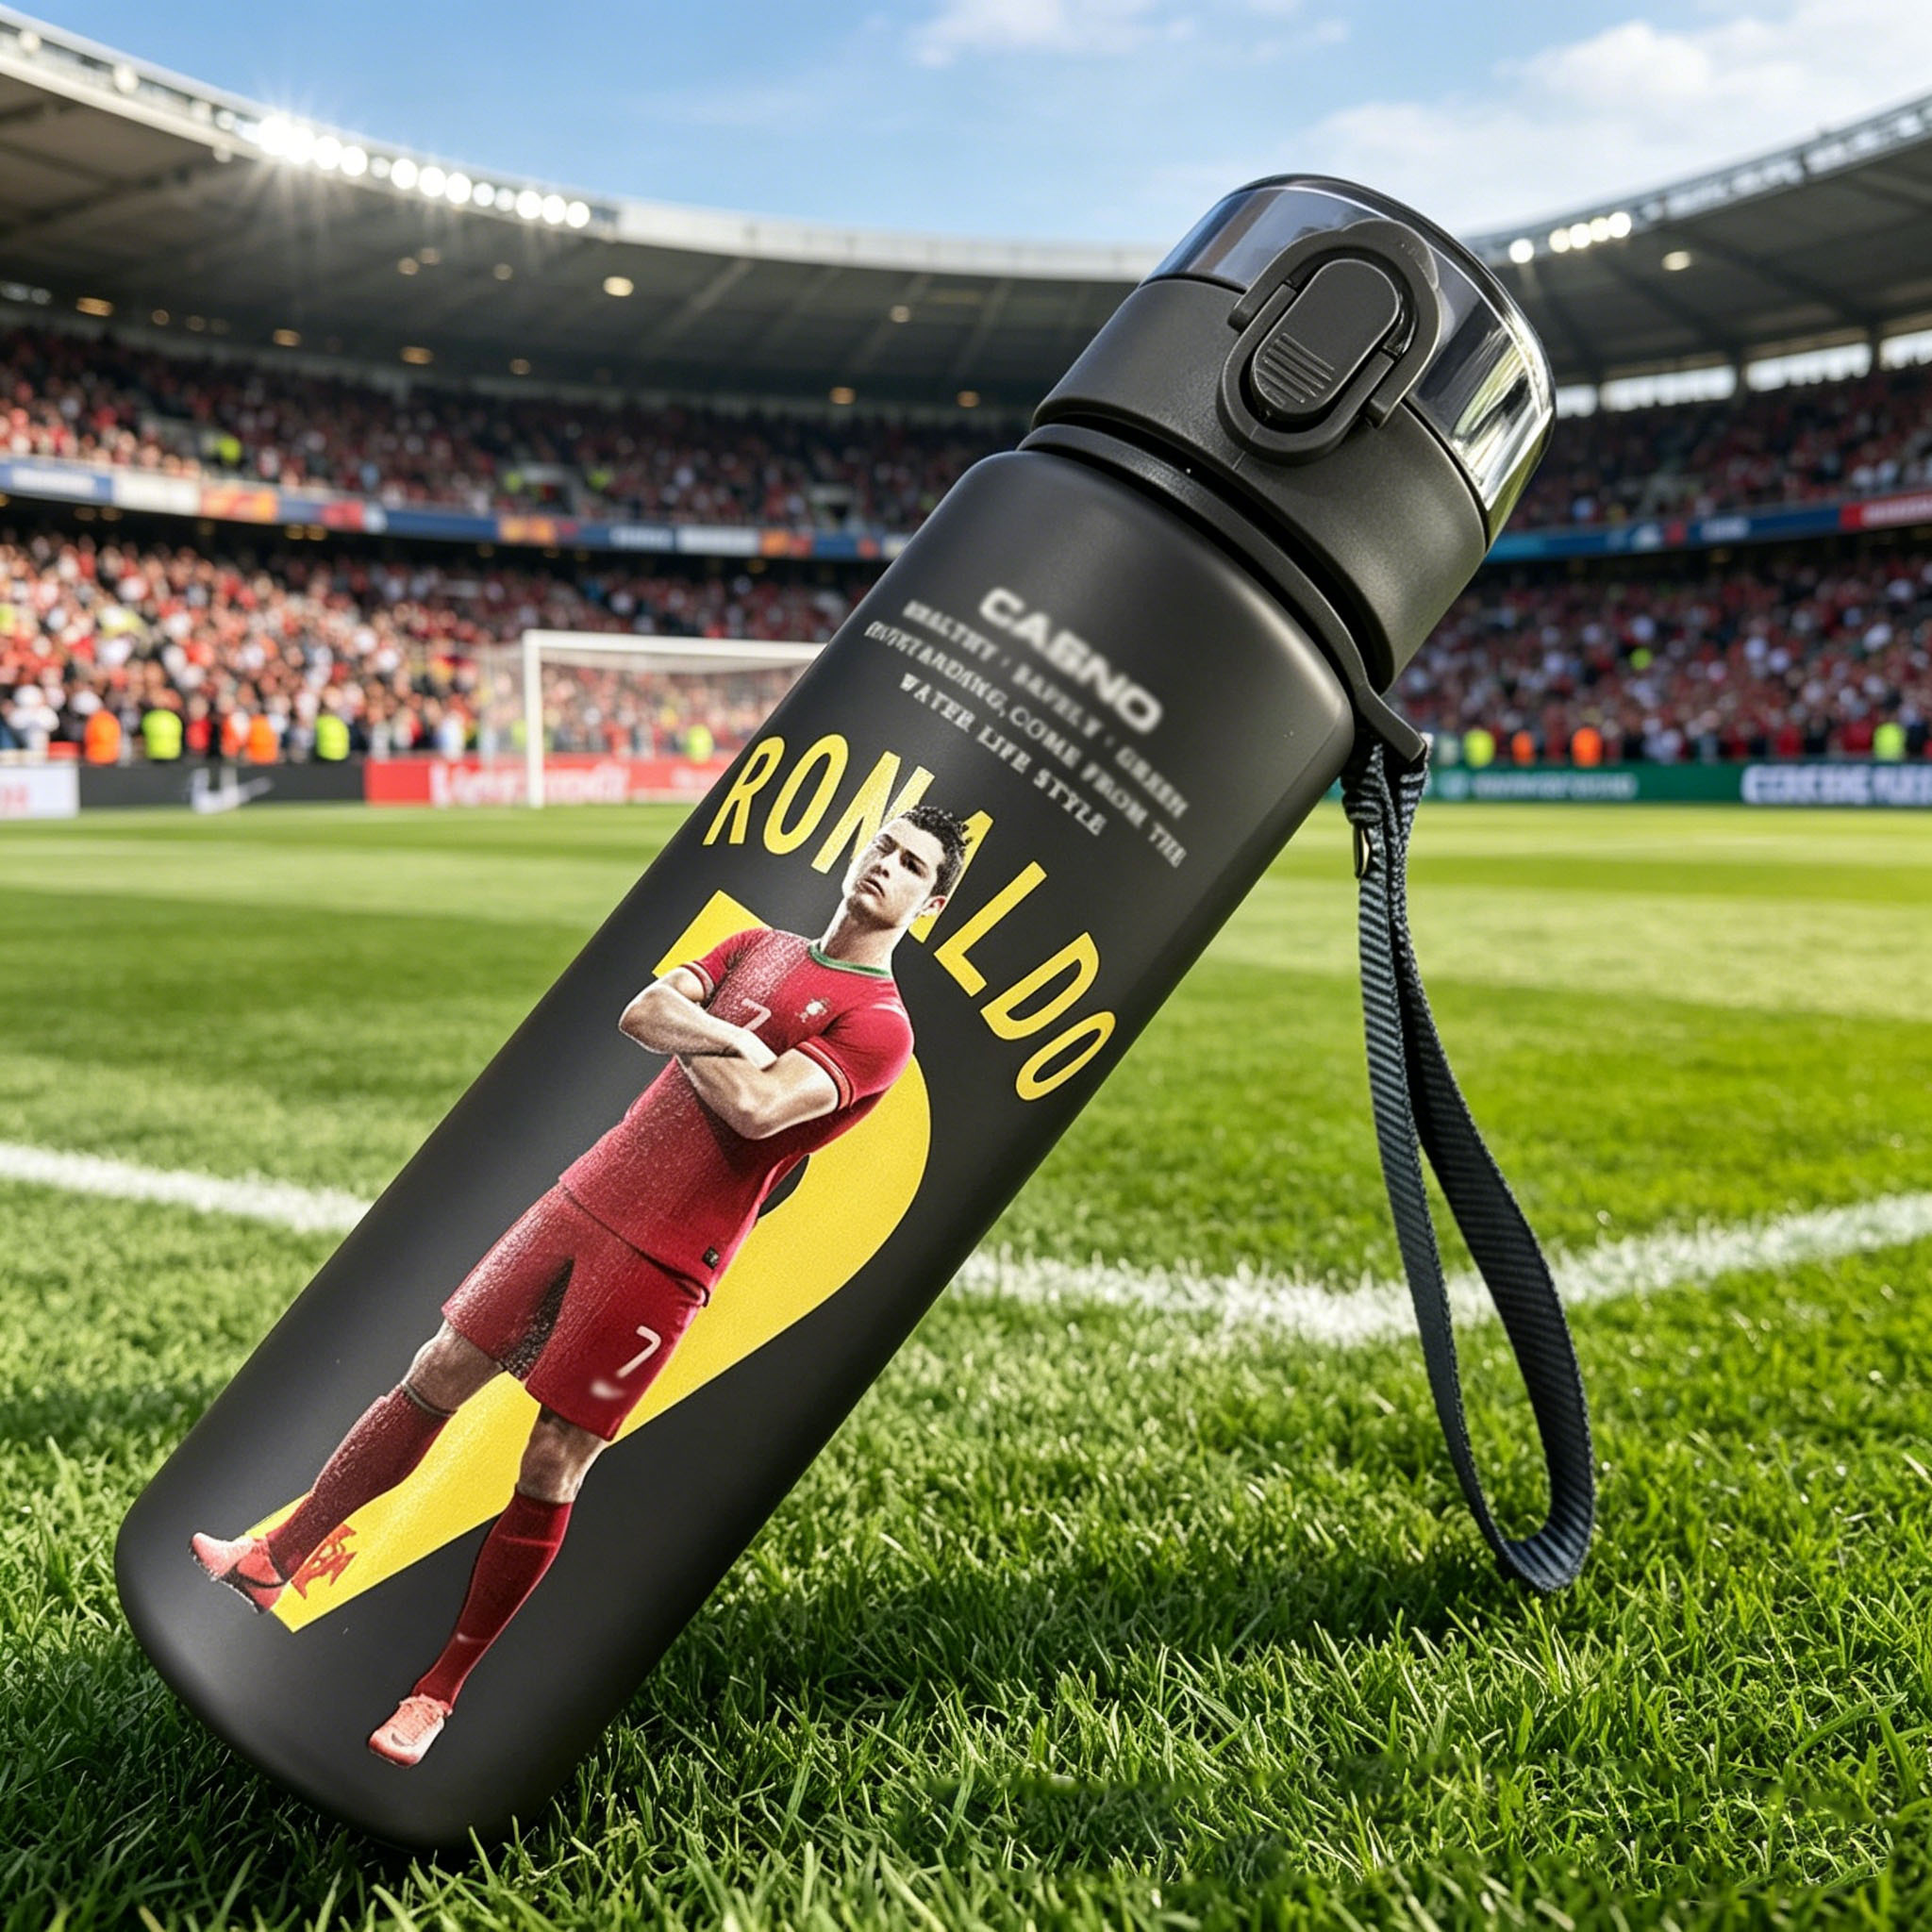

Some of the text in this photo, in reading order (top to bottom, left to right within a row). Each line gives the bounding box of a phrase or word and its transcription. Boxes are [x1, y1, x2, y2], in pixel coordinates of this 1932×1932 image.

[899, 673, 1107, 836] WATER LIFE STYLE
[616, 1324, 661, 1378] 7
